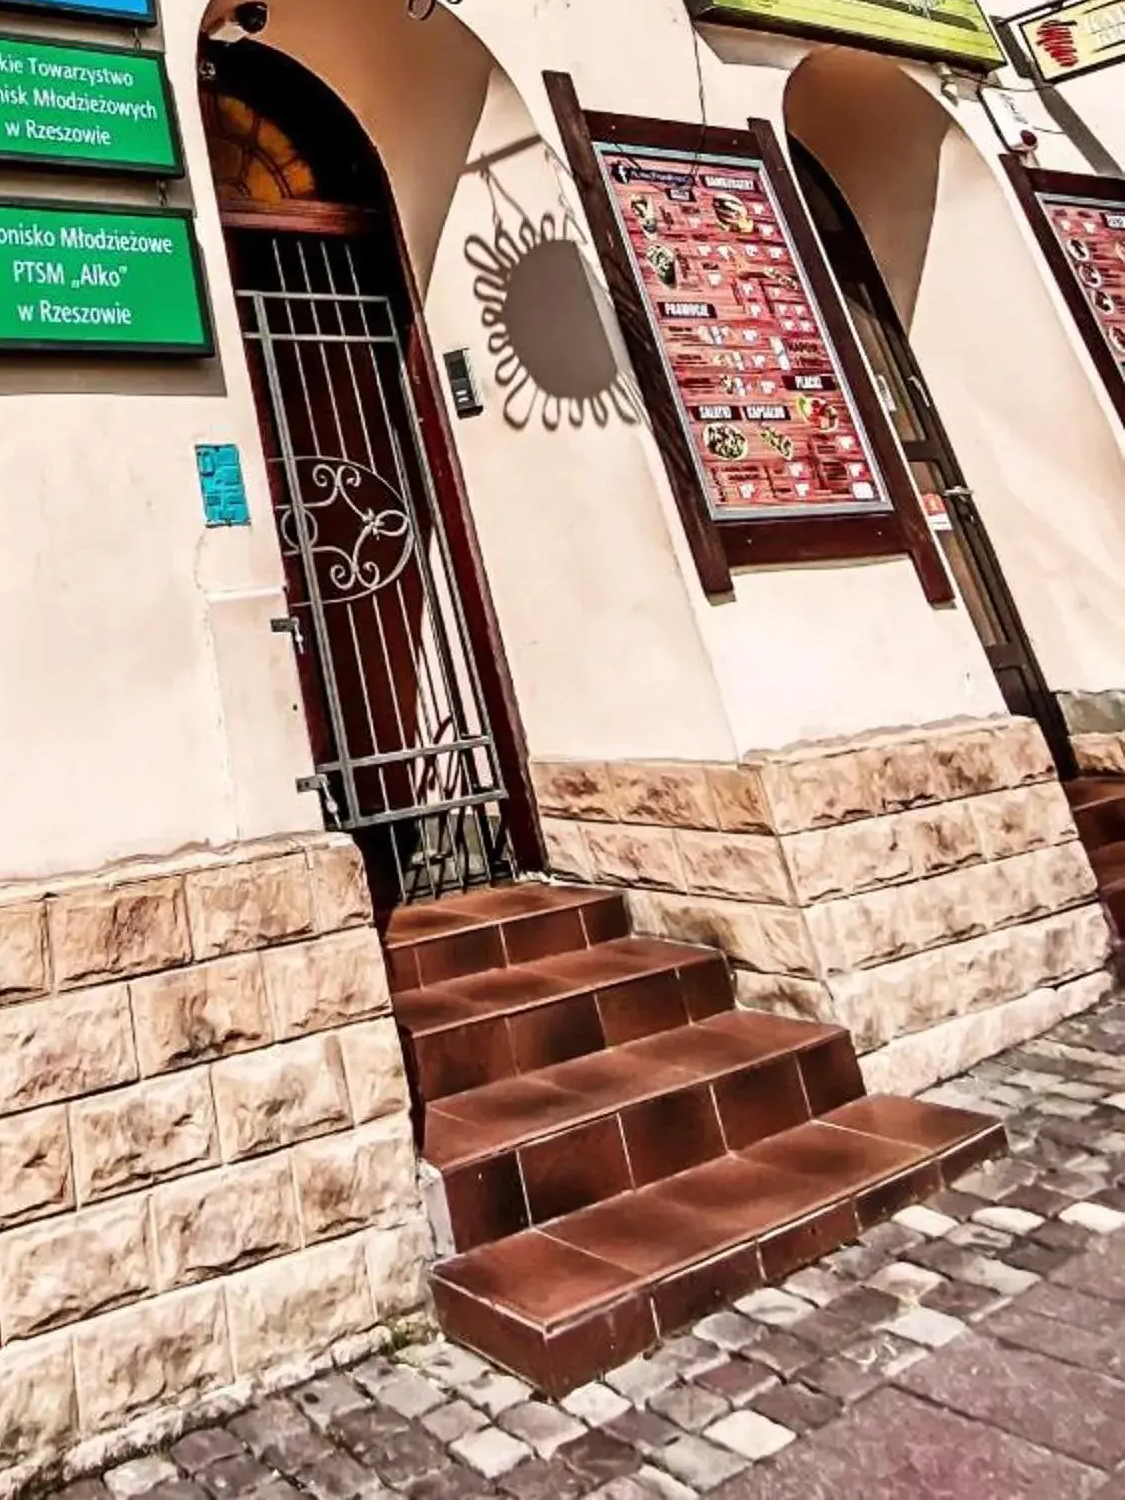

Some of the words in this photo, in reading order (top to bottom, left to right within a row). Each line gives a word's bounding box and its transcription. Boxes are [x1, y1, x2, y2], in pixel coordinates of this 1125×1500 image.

[27, 57, 134, 87] Towarzystwo
[32, 87, 158, 121] Młodzieżowych
[4, 122, 21, 138] w
[24, 118, 113, 146] Rzeszowie
[59, 227, 174, 254] Młodzieżowe
[12, 259, 66, 285] PTSM
[16, 304, 34, 322] w
[38, 299, 133, 325] Rzeszowie
